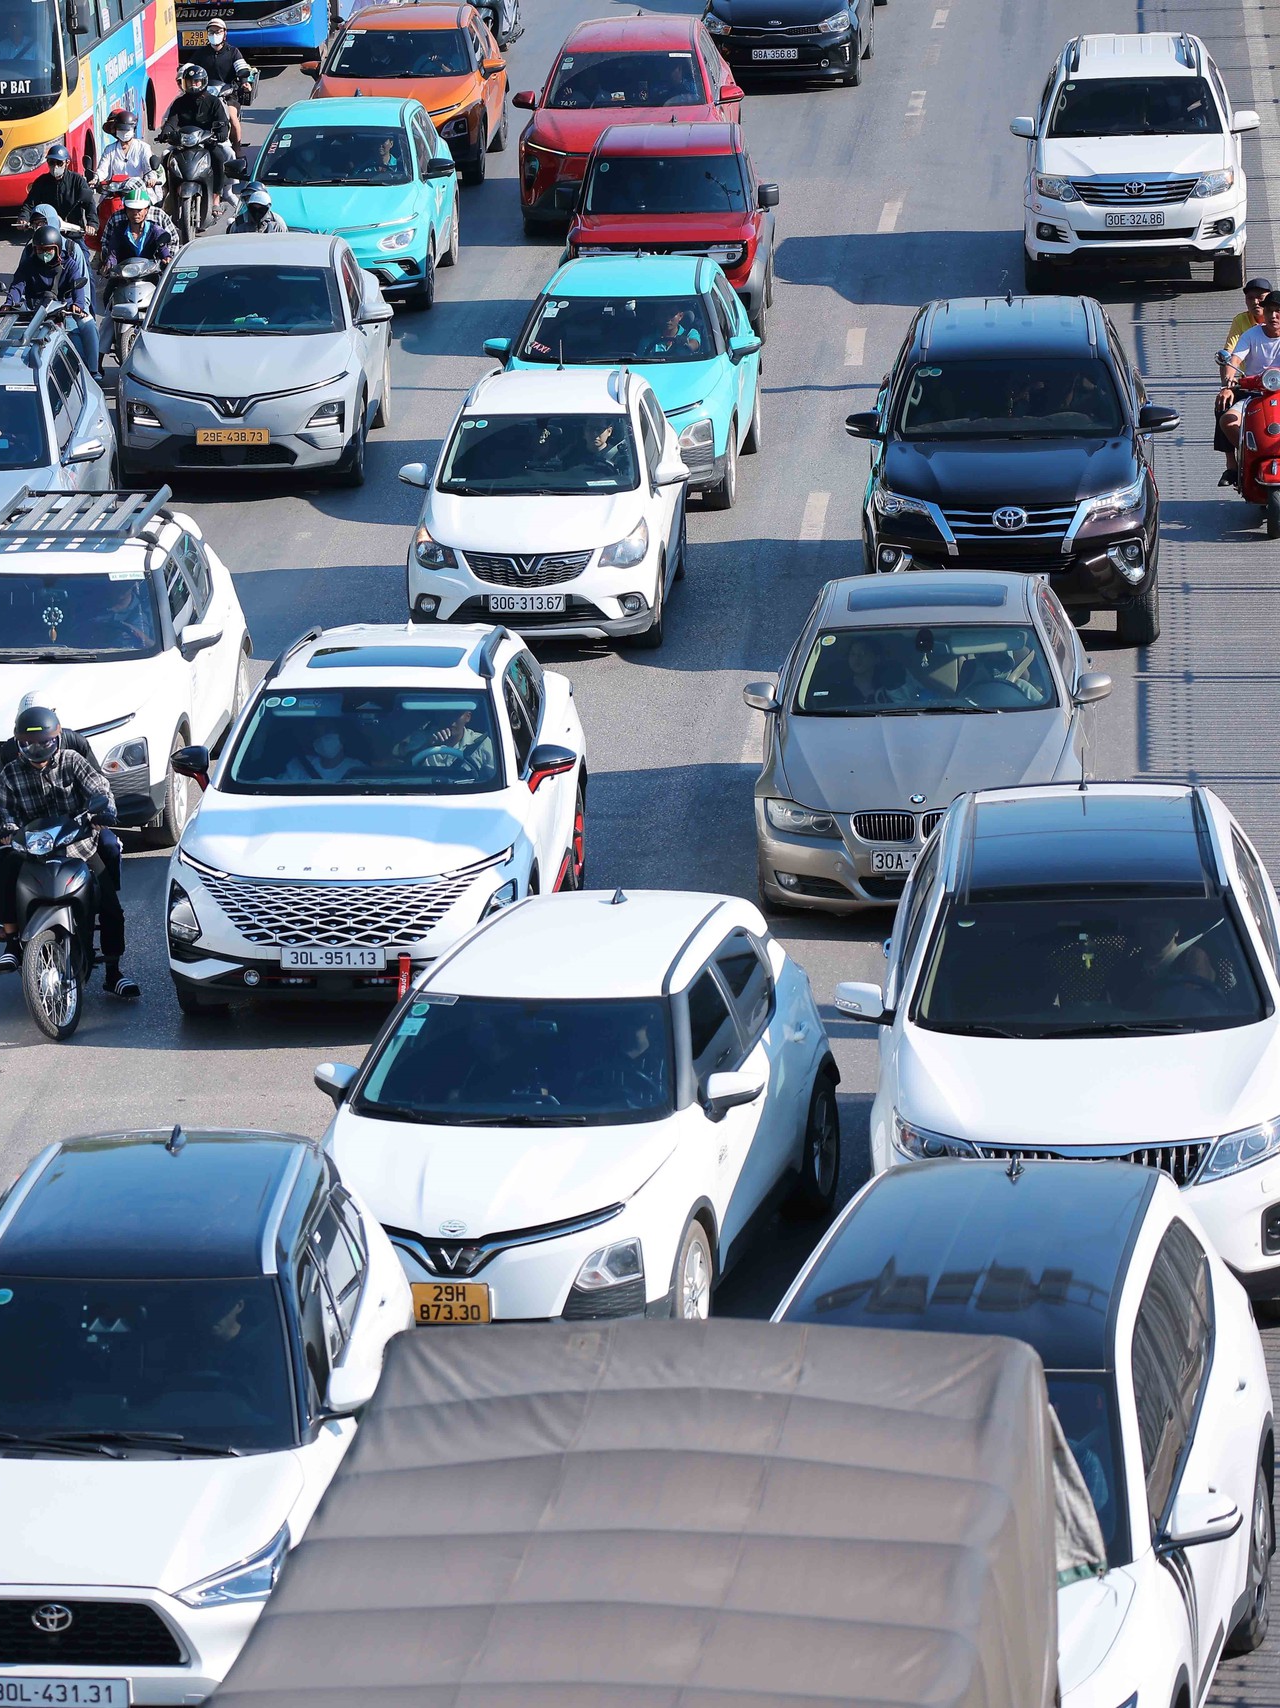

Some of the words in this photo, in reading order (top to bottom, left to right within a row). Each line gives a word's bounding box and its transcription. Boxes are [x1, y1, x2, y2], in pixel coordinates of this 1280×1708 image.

[1108, 214, 1163, 226] 30E-324.86
[531, 341, 551, 354] TAXI
[203, 432, 263, 442] 29E-438.73
[491, 596, 562, 611] 30G-313.67
[290, 952, 376, 965] 30L-951.13
[433, 1285, 466, 1302] 29H
[420, 1304, 480, 1321] 873.30
